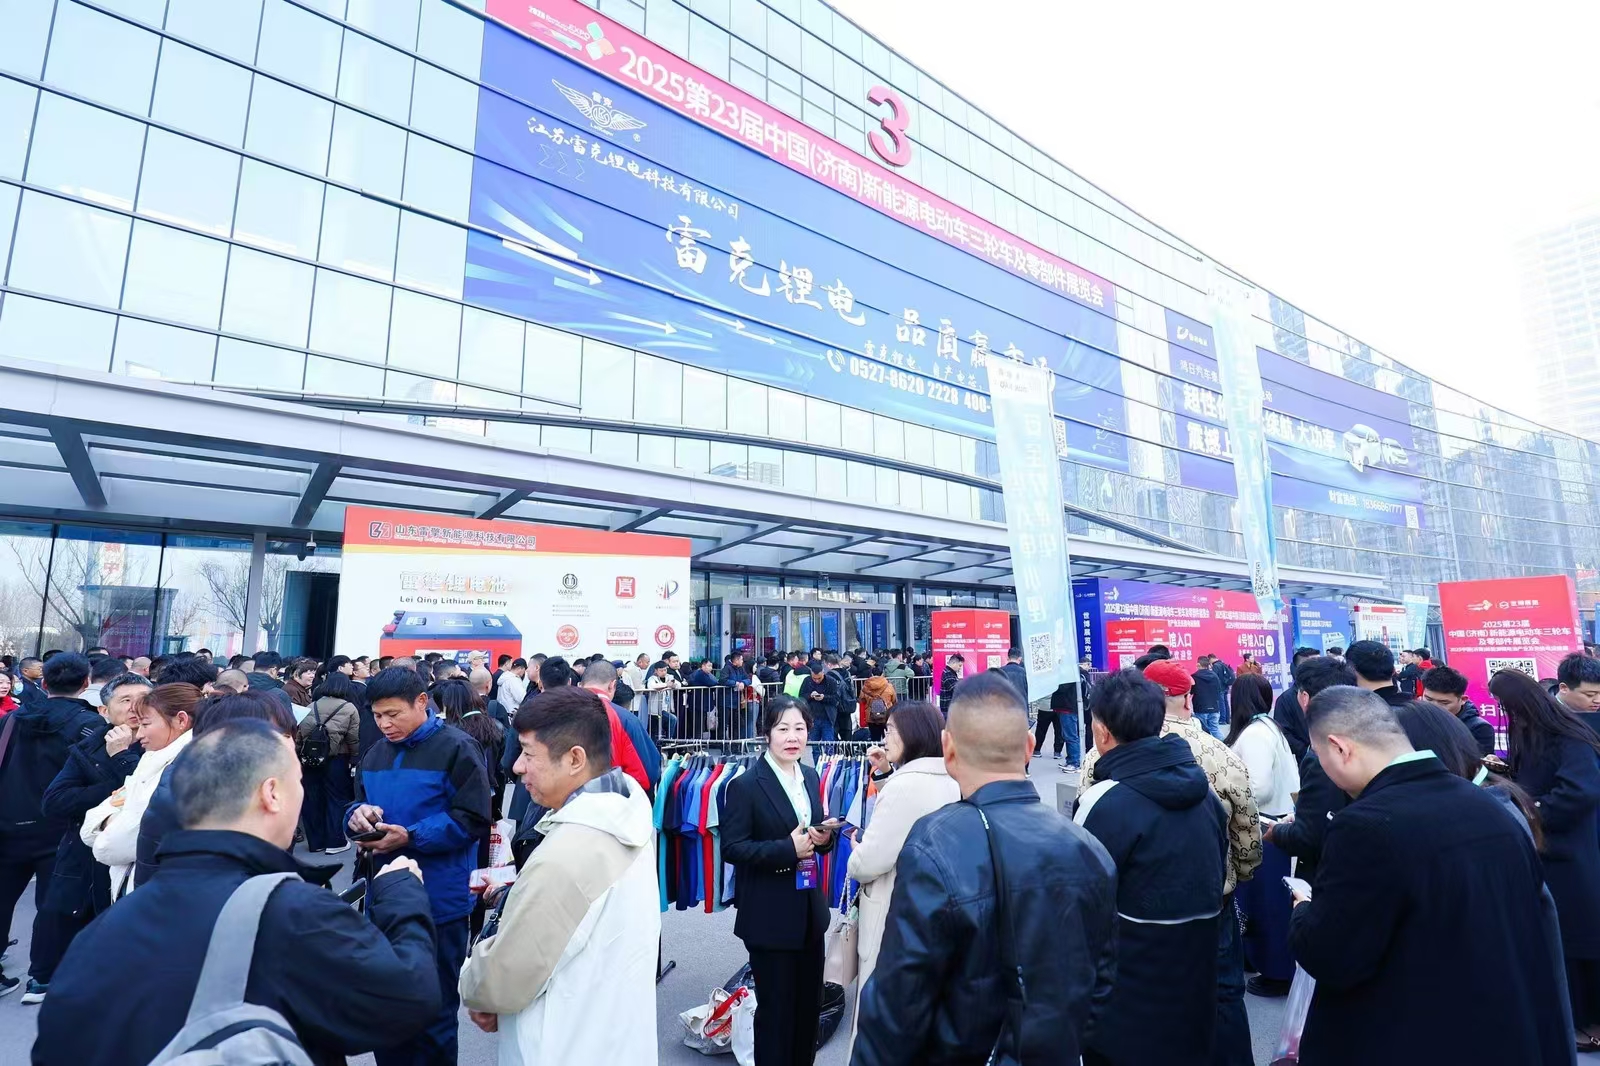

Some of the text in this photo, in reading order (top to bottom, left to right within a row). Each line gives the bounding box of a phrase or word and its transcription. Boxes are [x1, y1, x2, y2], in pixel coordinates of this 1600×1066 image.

[866, 85, 912, 168] 3
[527, 116, 740, 219] 江苏雷克锂电科技有限公司
[619, 46, 1104, 308] 2025第23届中国(济南)新能源电动车三轮车及零部件展览会
[665, 215, 868, 328] 雷克锂电
[850, 357, 924, 395] 0527-8620
[927, 381, 958, 406] 2228
[395, 524, 536, 546] 山东雷擎新能源科技有限公司
[416, 596, 438, 605] Qing
[441, 597, 474, 605] Lithium
[477, 598, 508, 607] Battery
[1449, 627, 1571, 638] 中国(济南)新能源电动车三轮车
[1483, 619, 1530, 628] 2025第23届
[1478, 637, 1540, 647] 及零部件展览会
